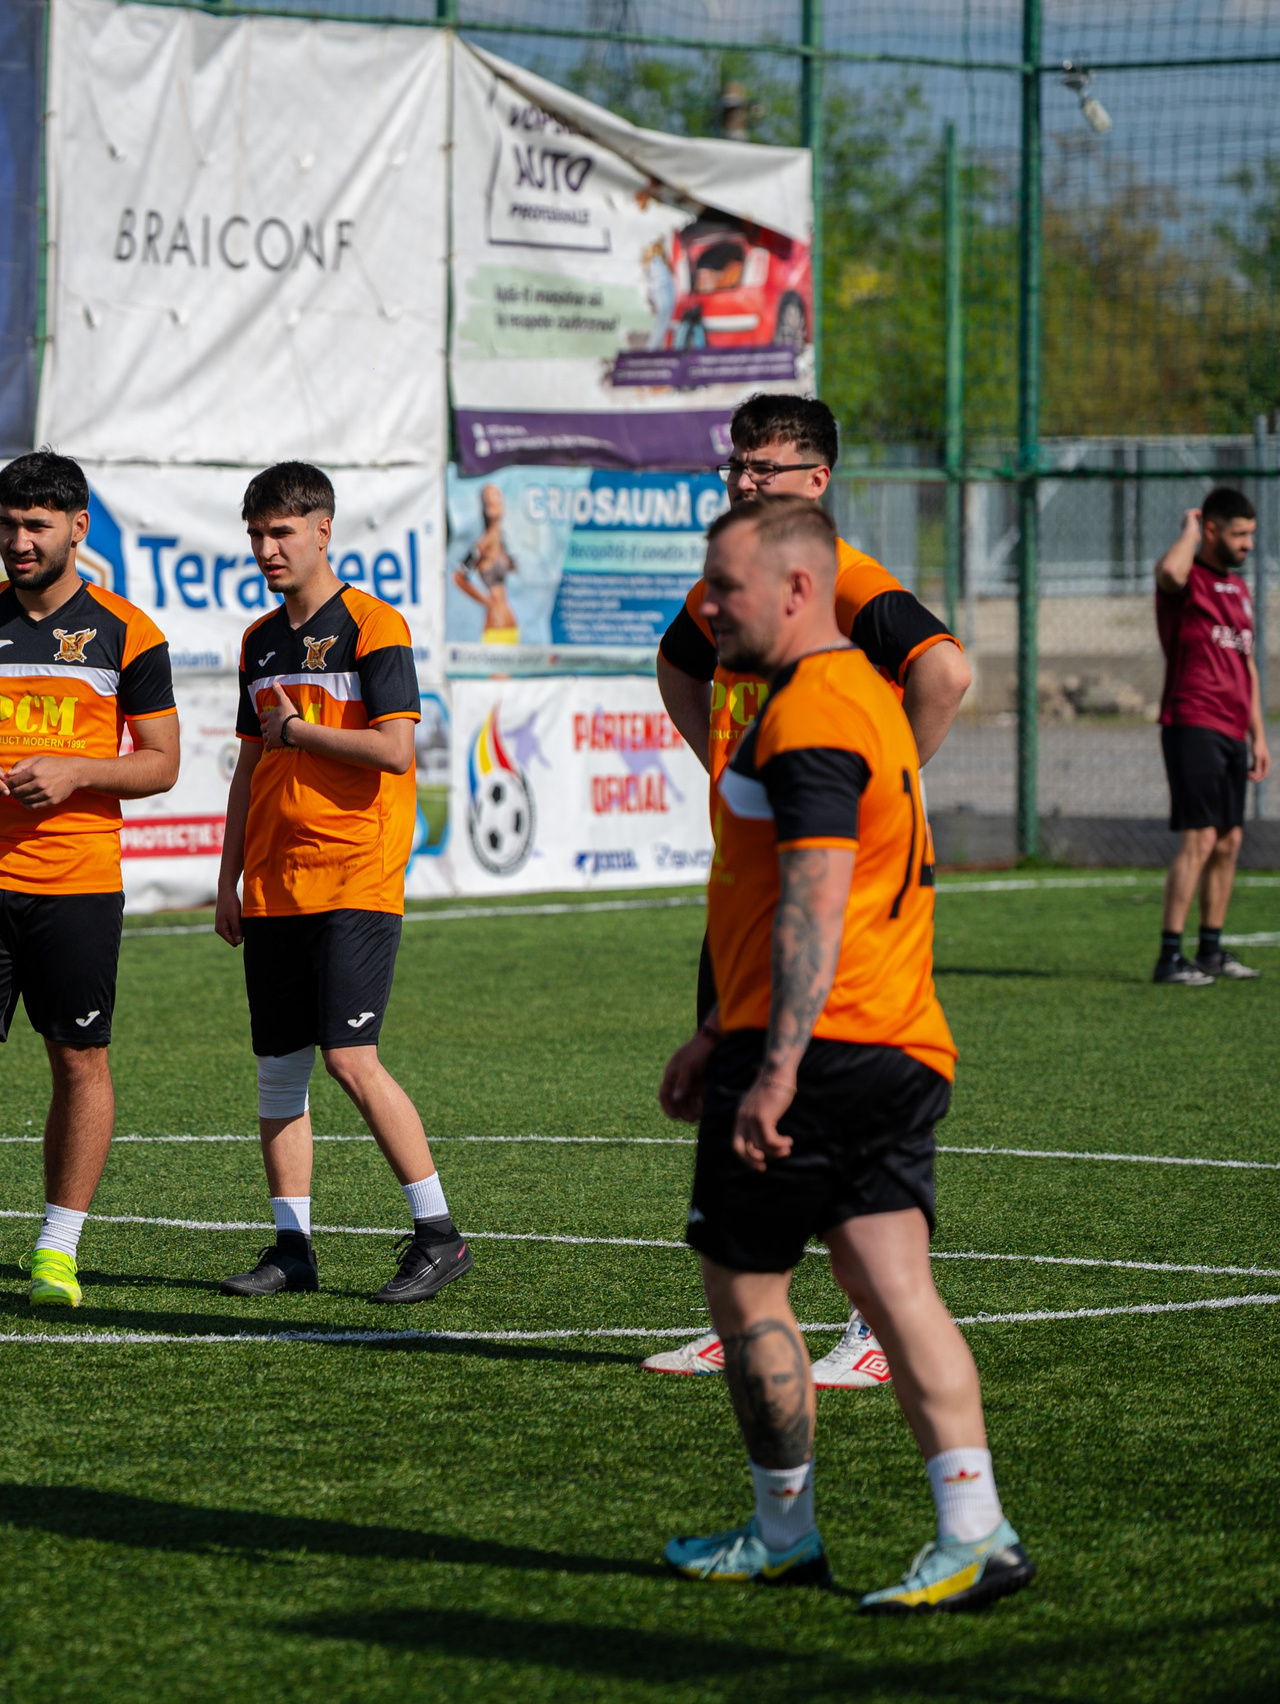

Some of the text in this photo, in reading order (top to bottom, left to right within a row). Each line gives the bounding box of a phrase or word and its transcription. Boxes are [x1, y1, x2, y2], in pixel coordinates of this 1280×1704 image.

[113, 206, 356, 273] BRAICONF
[136, 530, 421, 610] Teraeel
[22, 737, 65, 748] MODERN
[67, 740, 87, 749] 1992
[590, 774, 669, 816] OFICIAL
